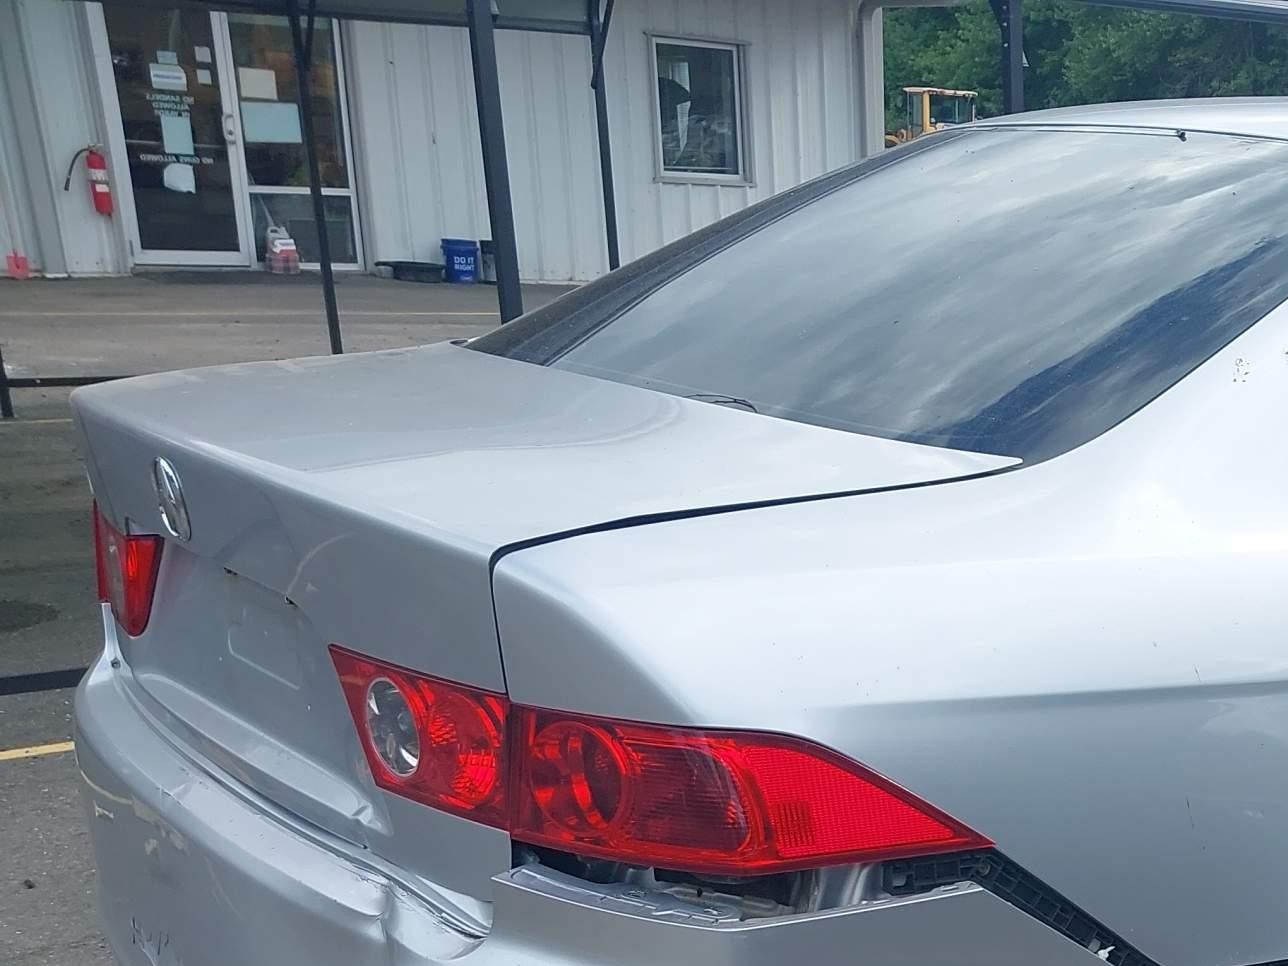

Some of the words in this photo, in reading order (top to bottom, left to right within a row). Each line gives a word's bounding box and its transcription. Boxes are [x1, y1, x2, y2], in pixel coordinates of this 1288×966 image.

[454, 256, 466, 264] DO
[467, 256, 474, 264] IT
[454, 263, 475, 271] RIGHT
